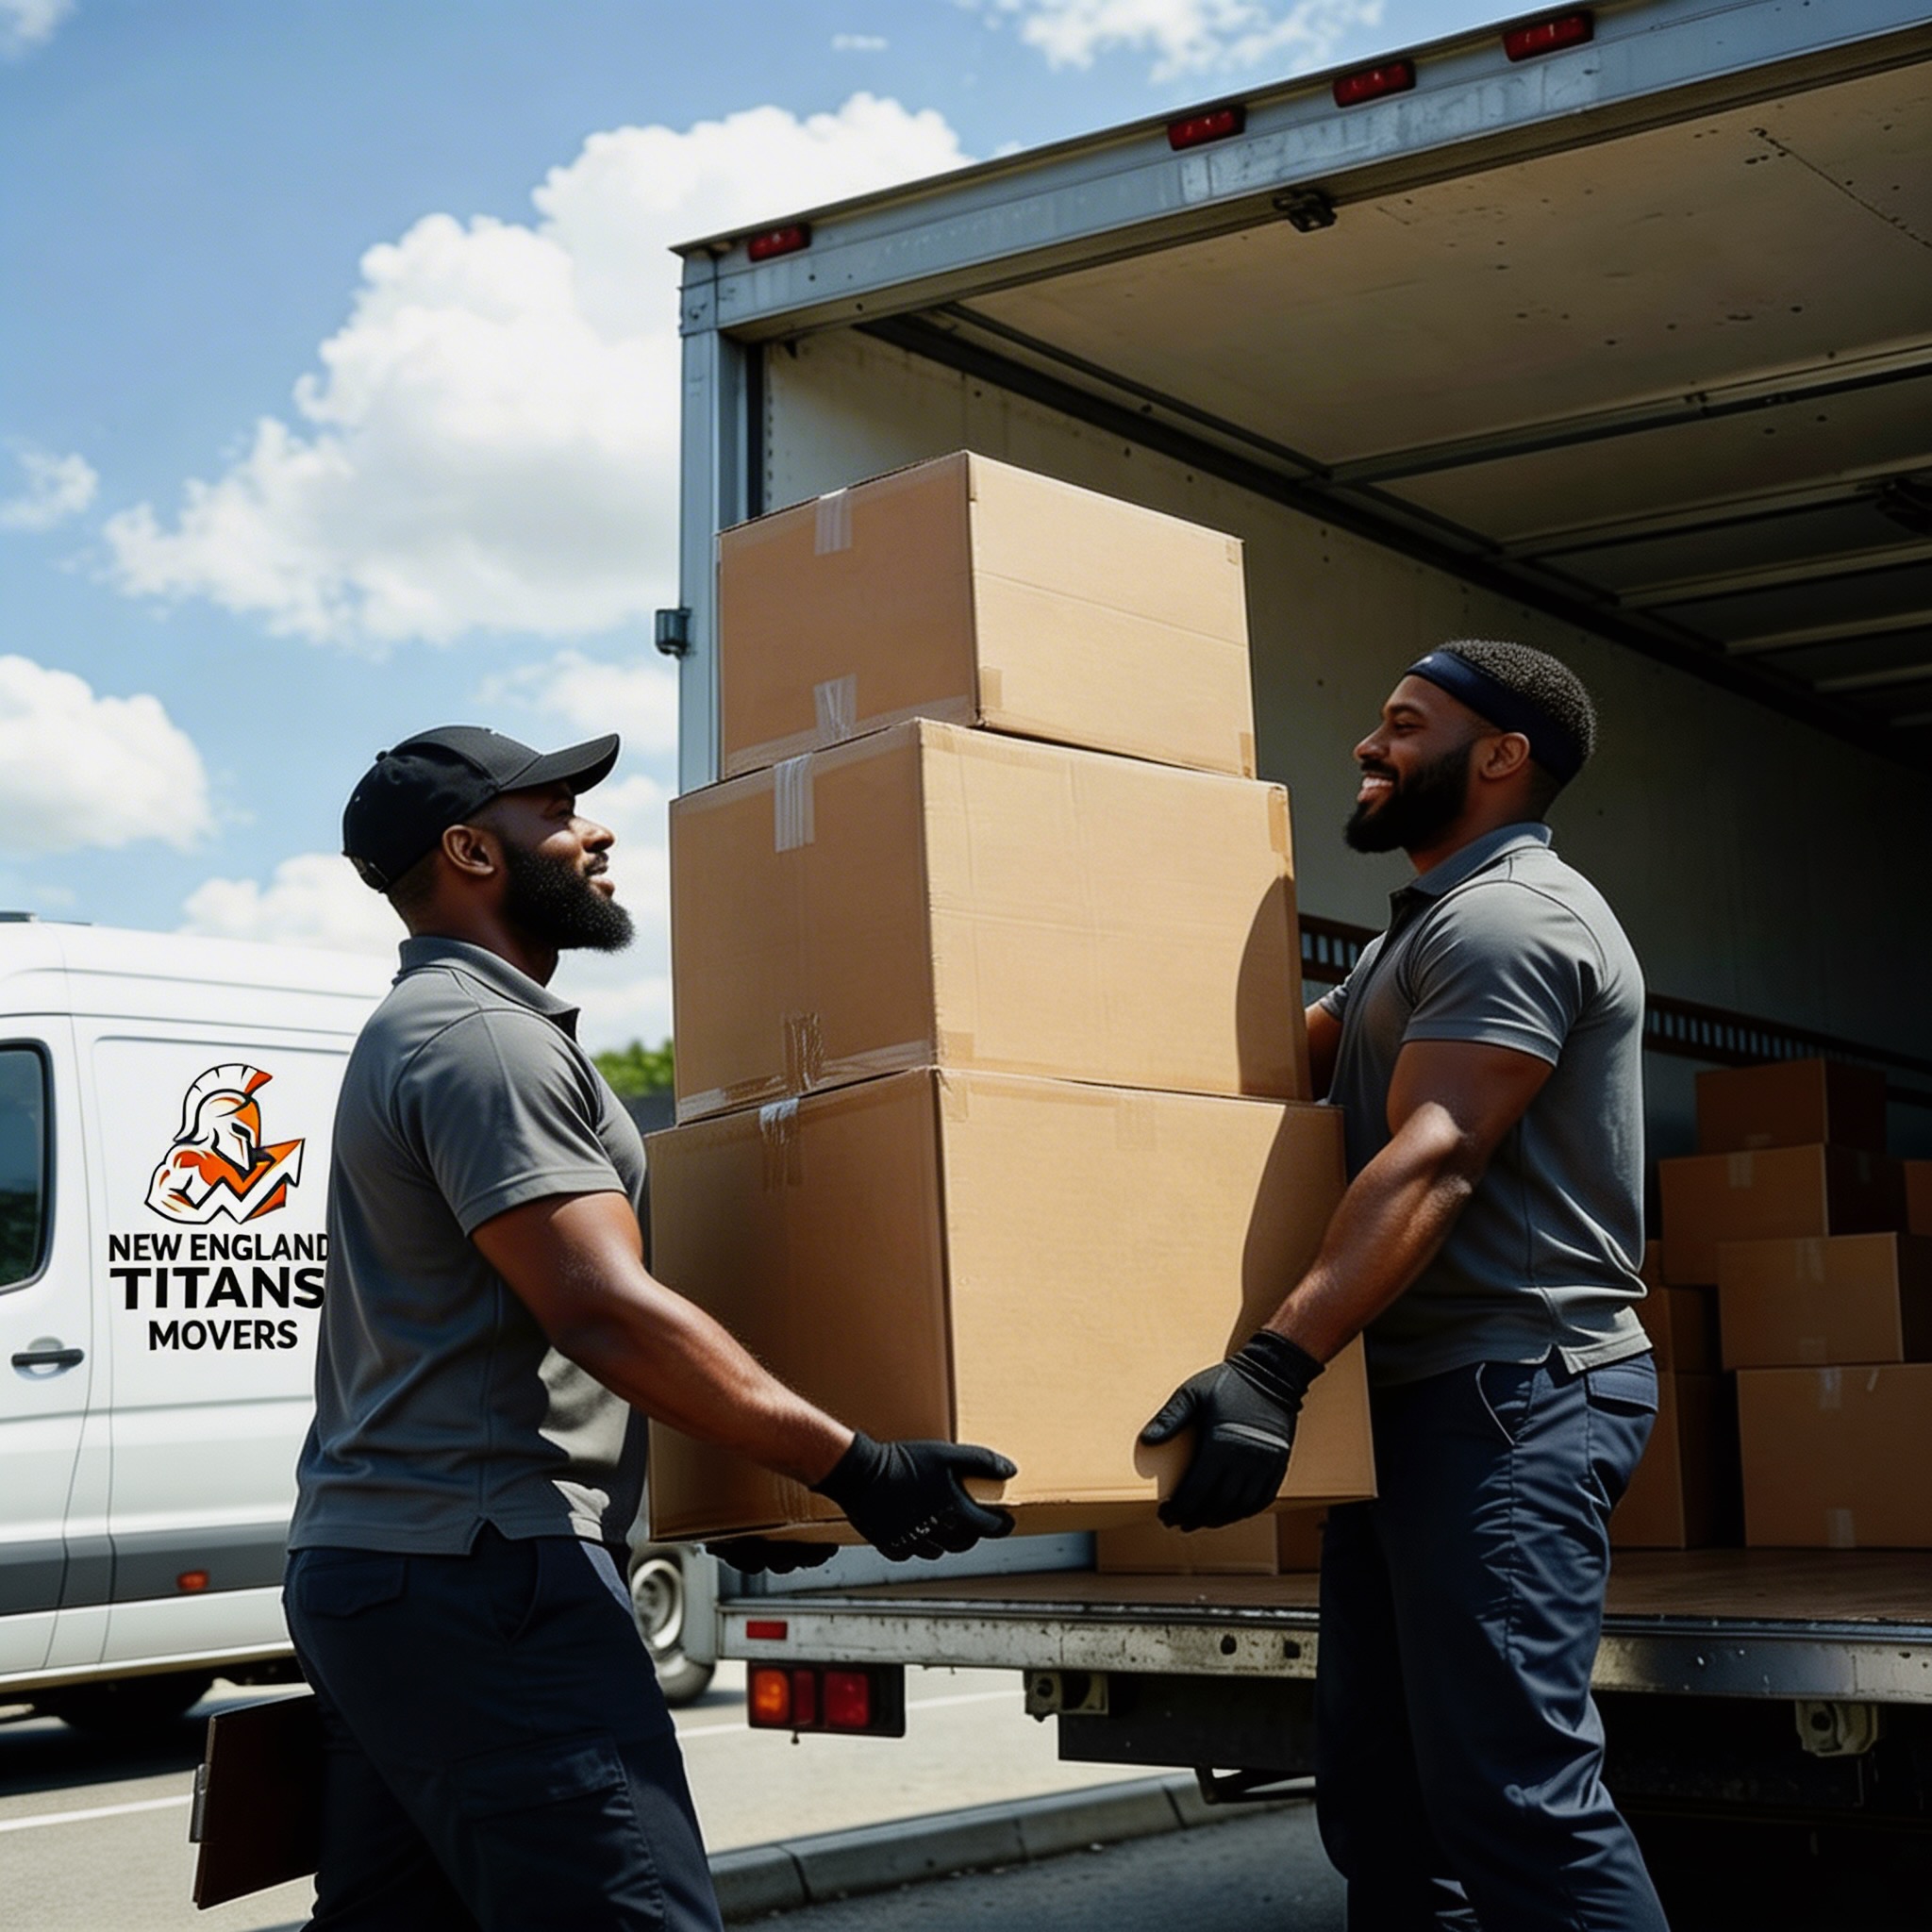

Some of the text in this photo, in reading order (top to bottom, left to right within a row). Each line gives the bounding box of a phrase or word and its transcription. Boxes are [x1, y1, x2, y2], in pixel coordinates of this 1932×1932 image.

[108, 1233, 182, 1261] NEW
[109, 1267, 325, 1309] TITANS
[149, 1320, 298, 1351] MOVERS
